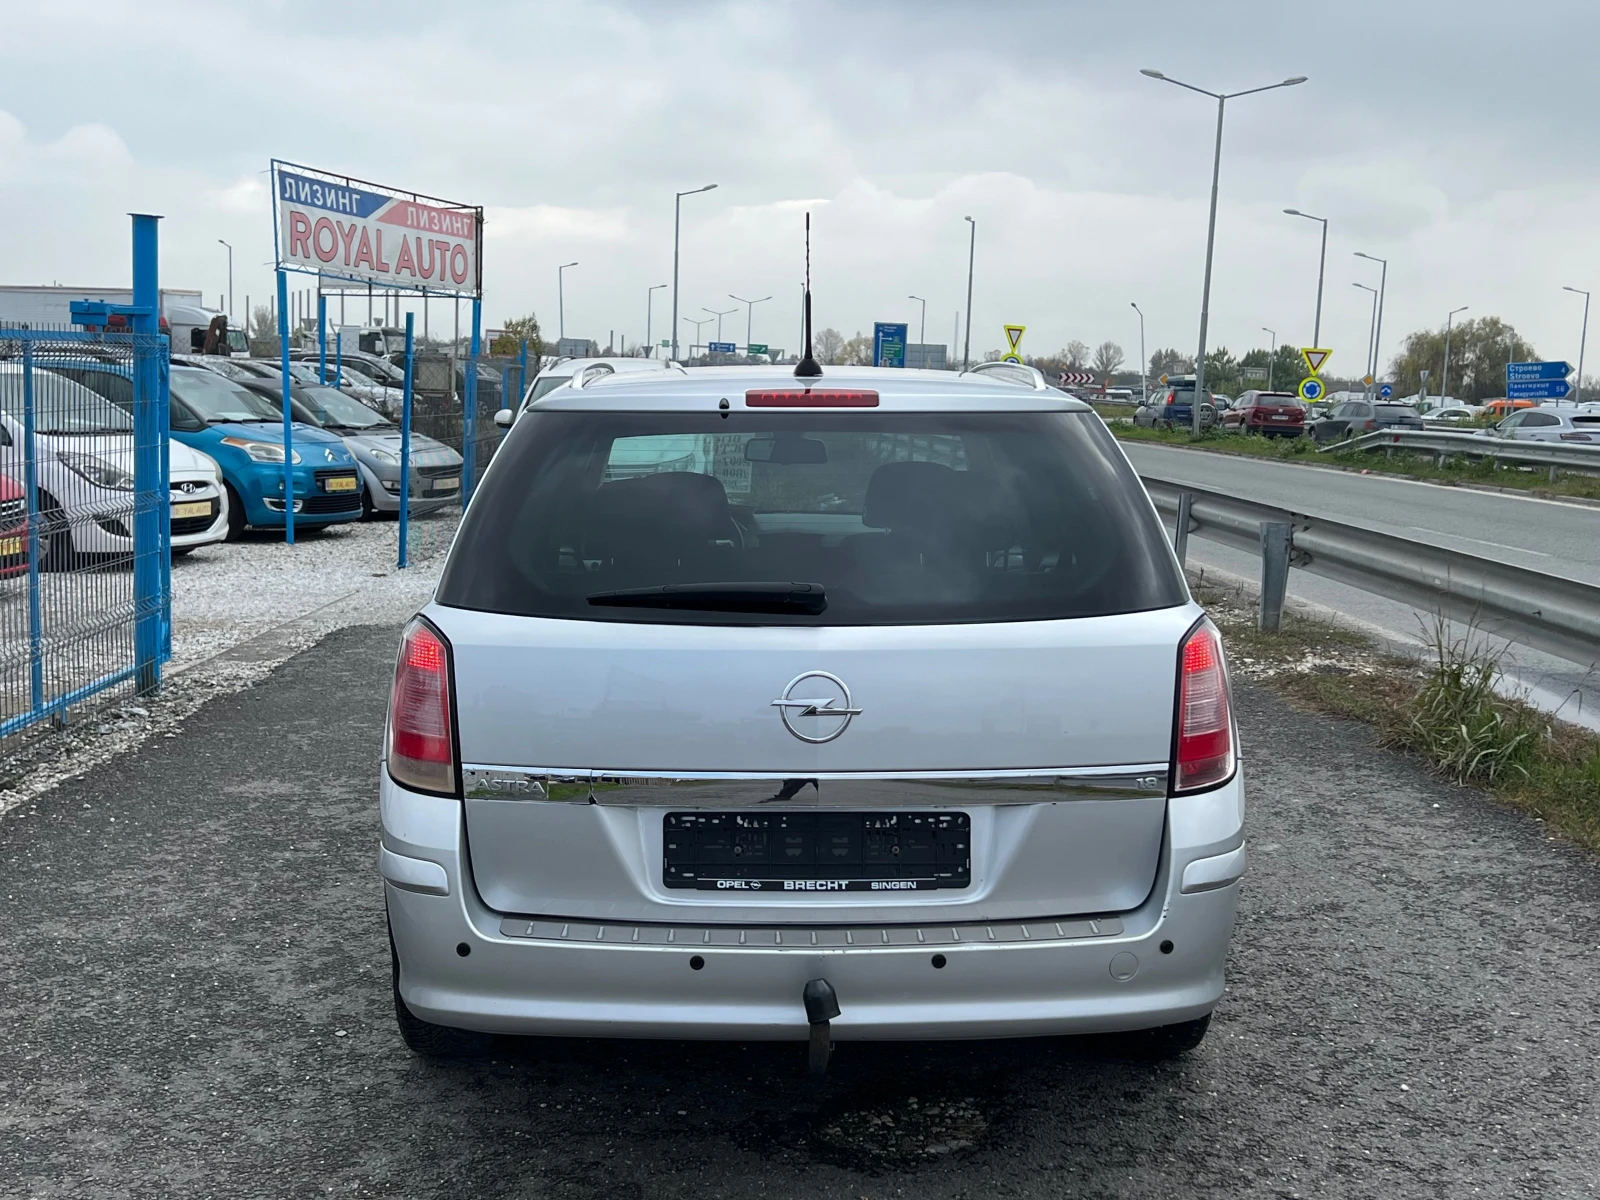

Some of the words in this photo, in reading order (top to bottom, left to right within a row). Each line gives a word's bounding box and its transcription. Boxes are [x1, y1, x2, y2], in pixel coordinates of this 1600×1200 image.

[285, 178, 360, 214] ЛИЗИНГ
[407, 206, 470, 236] ЛИЗИНГ
[290, 210, 390, 273] ROYAL
[395, 233, 468, 285] AUTO
[1509, 365, 1542, 373] Строево
[478, 779, 545, 794] ASTRA
[717, 880, 750, 889] OPEL
[784, 880, 849, 890] BRECHT
[871, 881, 917, 889] SINGEN
